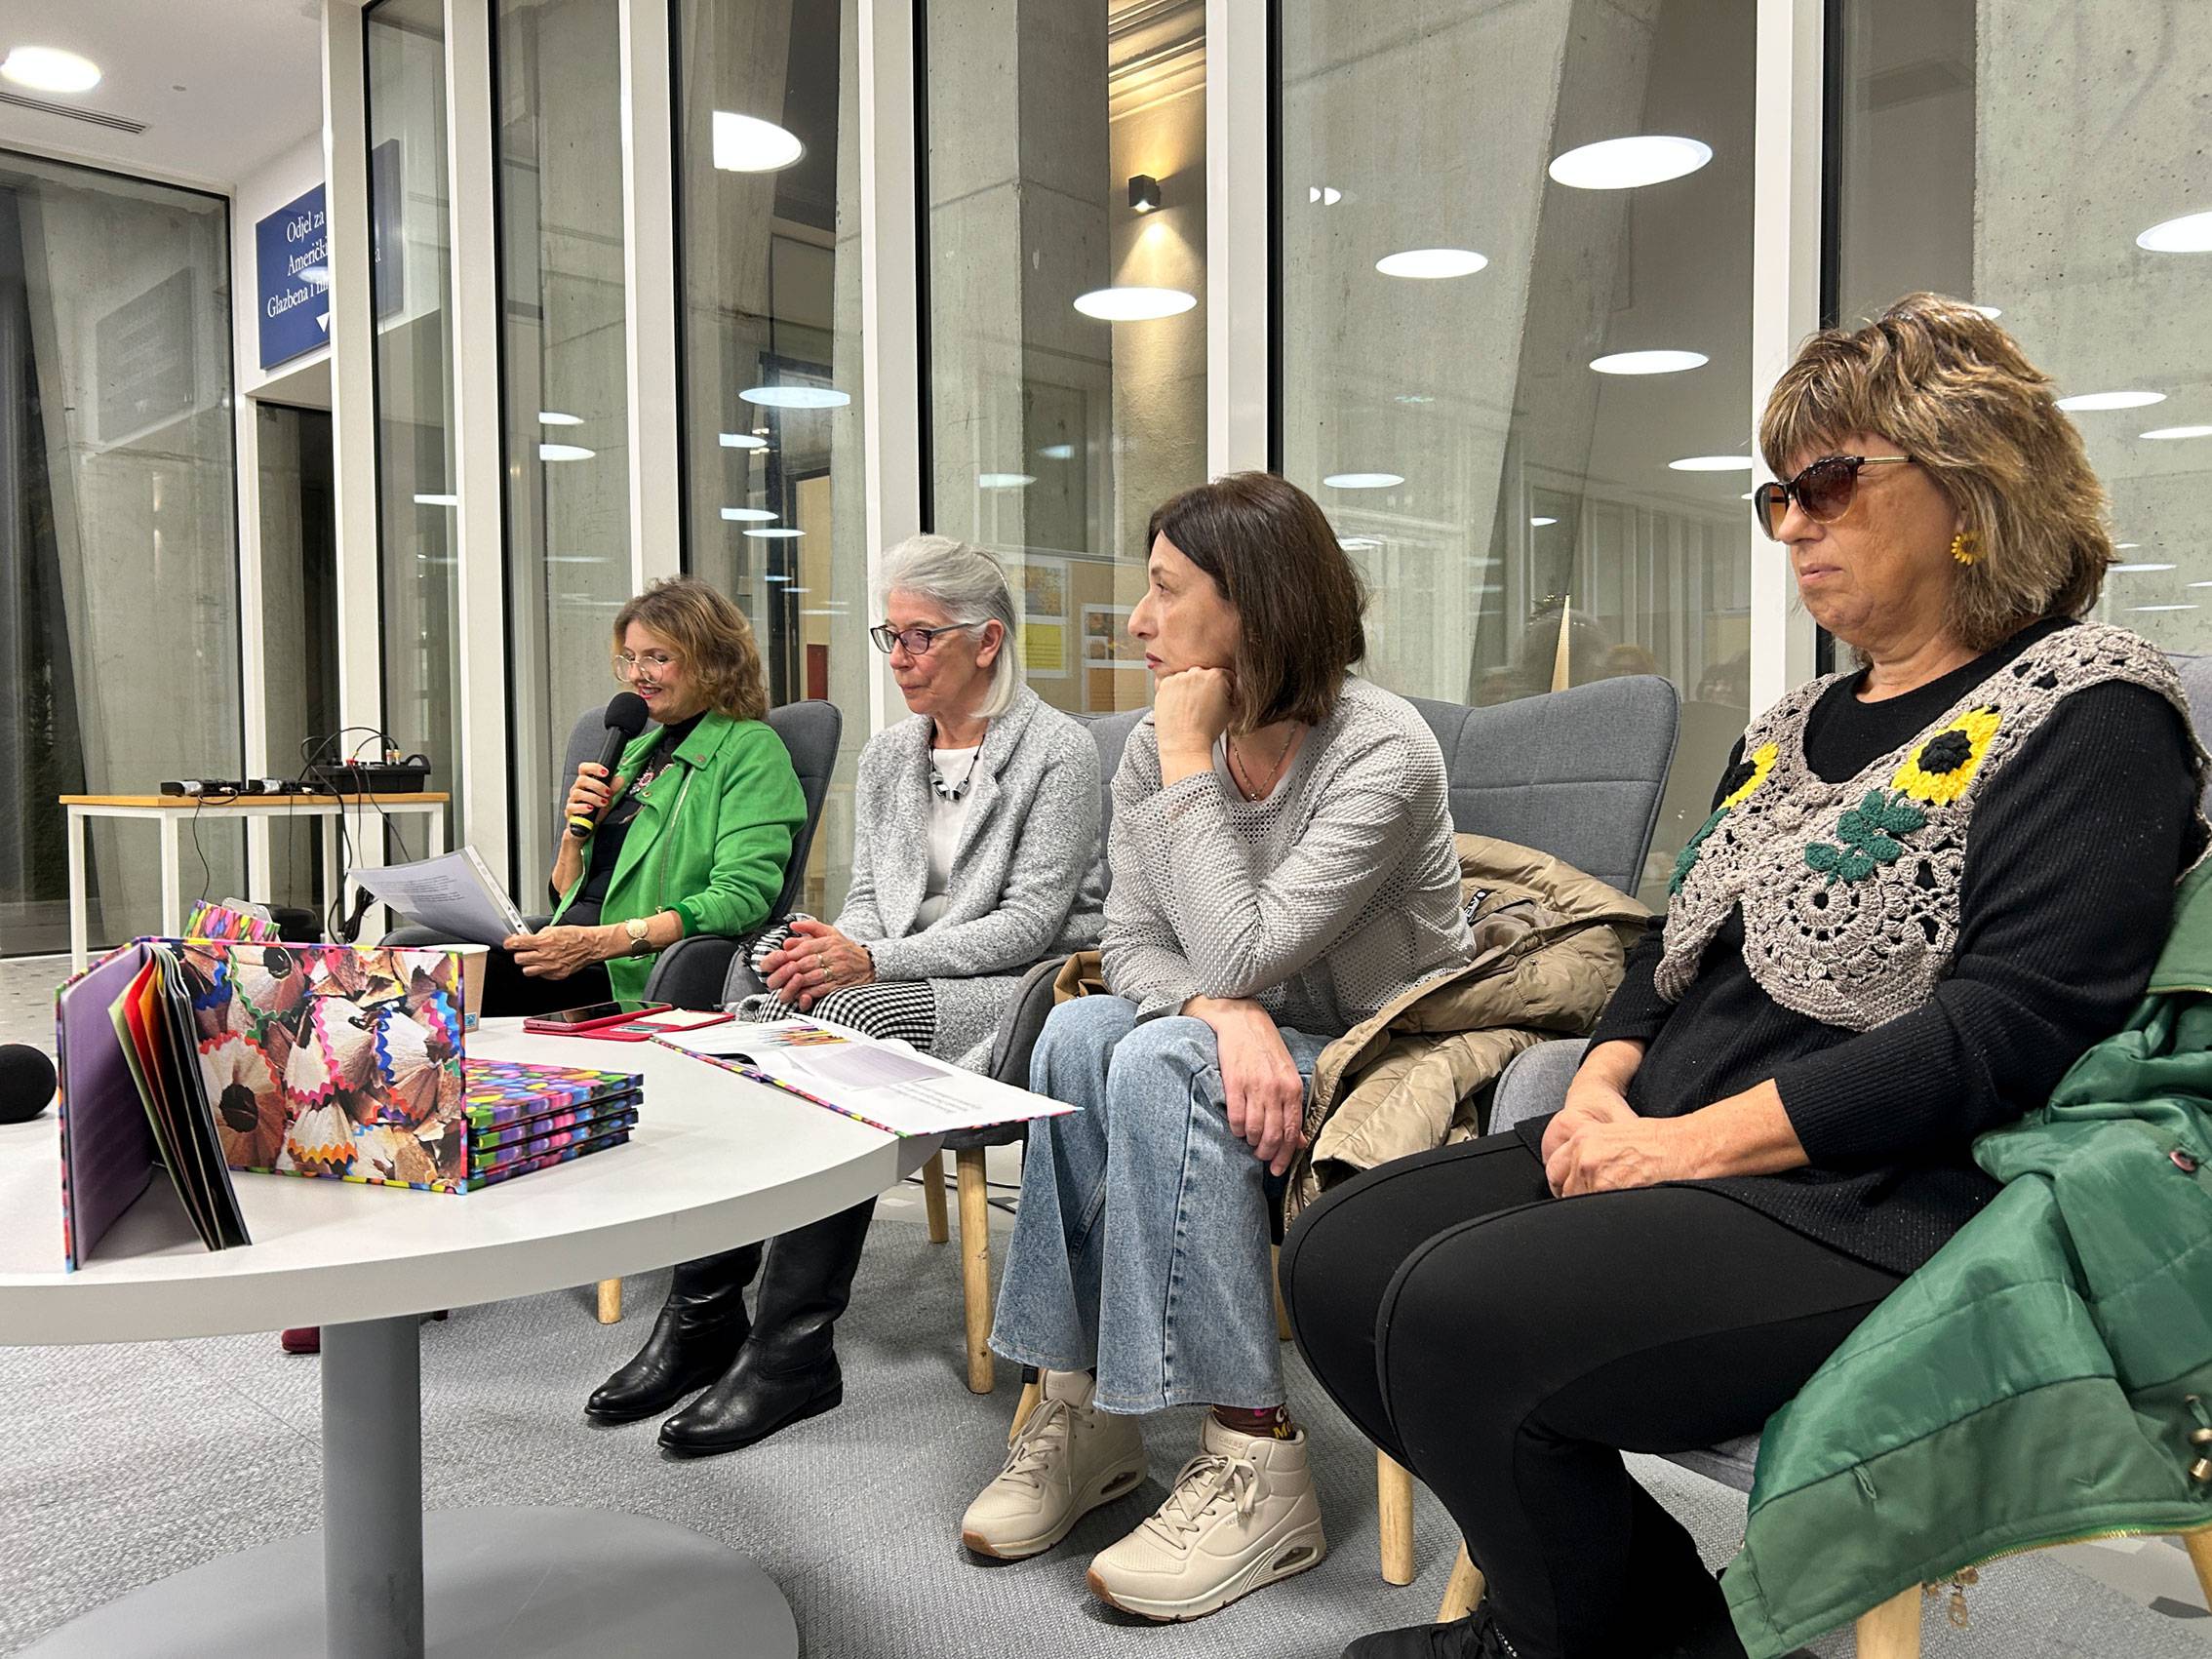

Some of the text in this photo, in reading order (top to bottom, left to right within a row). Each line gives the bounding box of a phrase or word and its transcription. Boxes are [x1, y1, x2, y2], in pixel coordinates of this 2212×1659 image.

[287, 211, 325, 243] Odjel za
[267, 289, 309, 318] Glazbena
